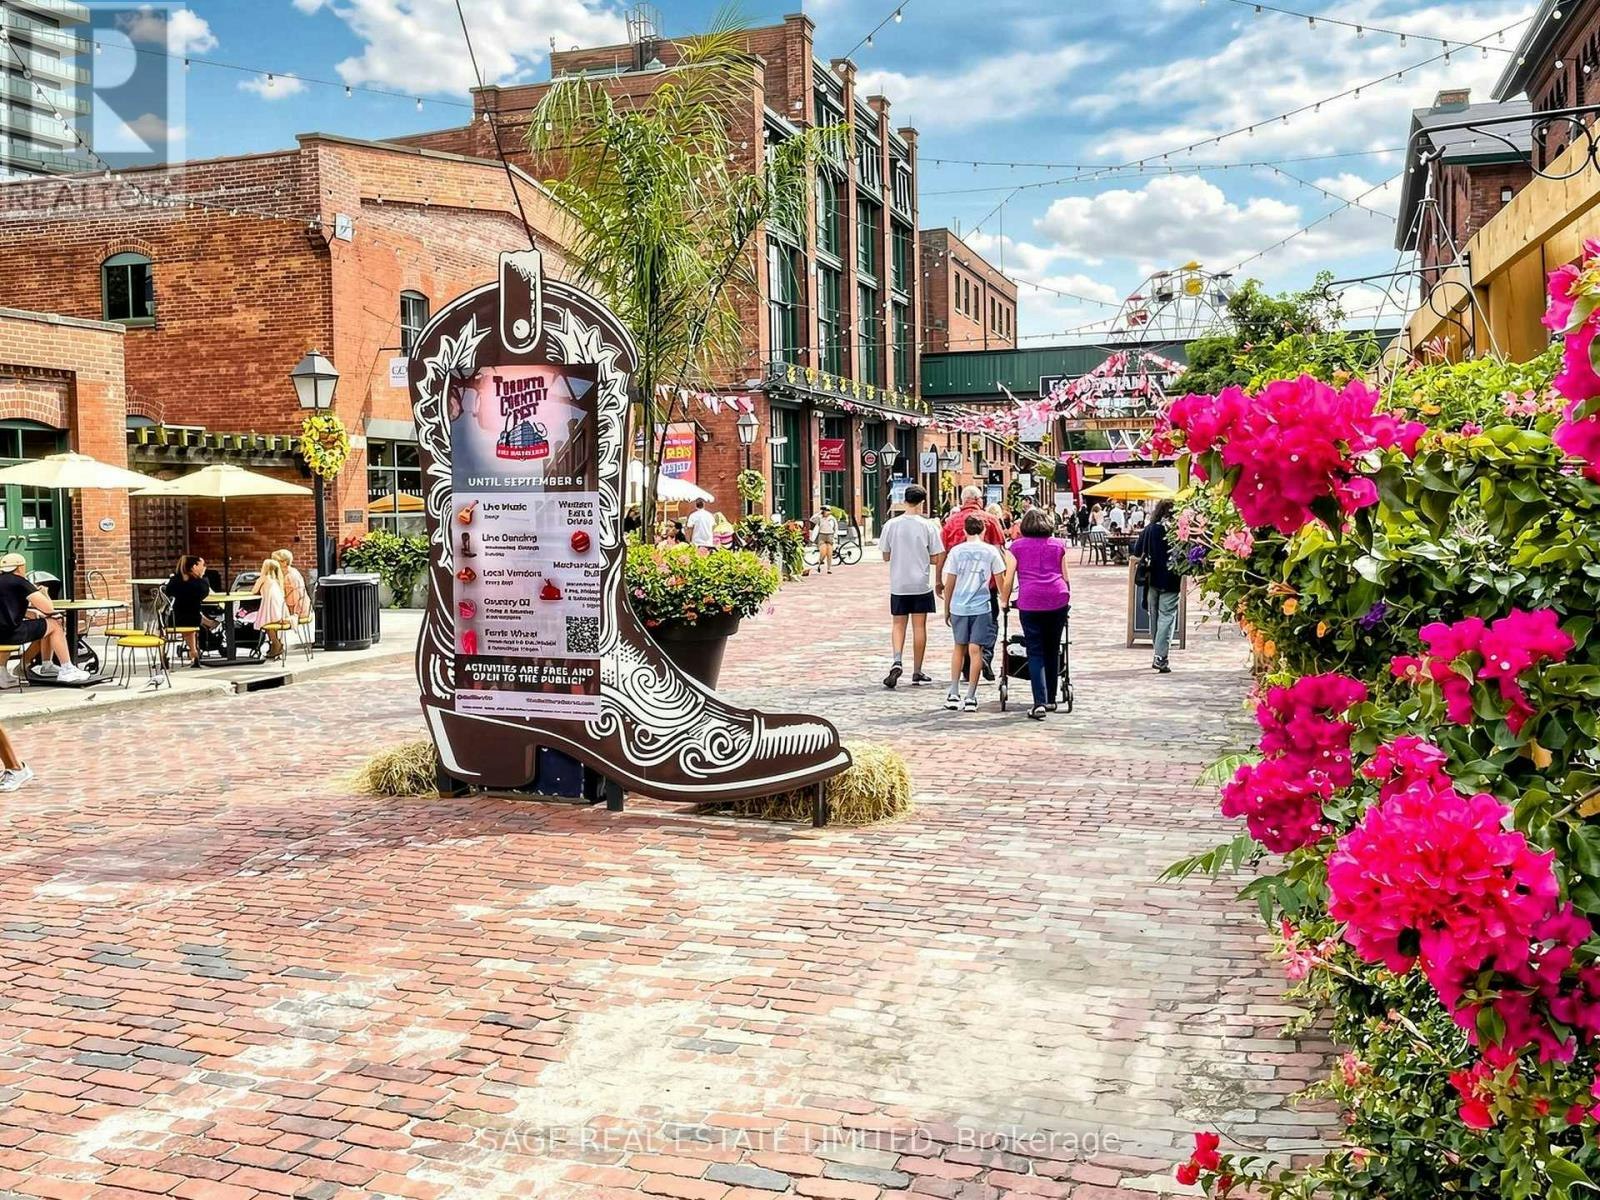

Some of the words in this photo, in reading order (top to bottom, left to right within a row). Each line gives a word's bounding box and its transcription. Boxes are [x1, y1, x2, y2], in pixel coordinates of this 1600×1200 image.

[468, 477, 502, 487] UNTIL
[504, 477, 572, 487] SEPTEMBER
[576, 477, 583, 486] 6
[483, 569, 504, 577] Local
[464, 663, 517, 674] ACTIVITIES
[520, 665, 540, 675] ARE
[543, 666, 568, 676] FREE
[572, 667, 594, 677] AND
[472, 672, 499, 681] OPEN
[503, 673, 515, 682] TO
[518, 674, 538, 683] THE
